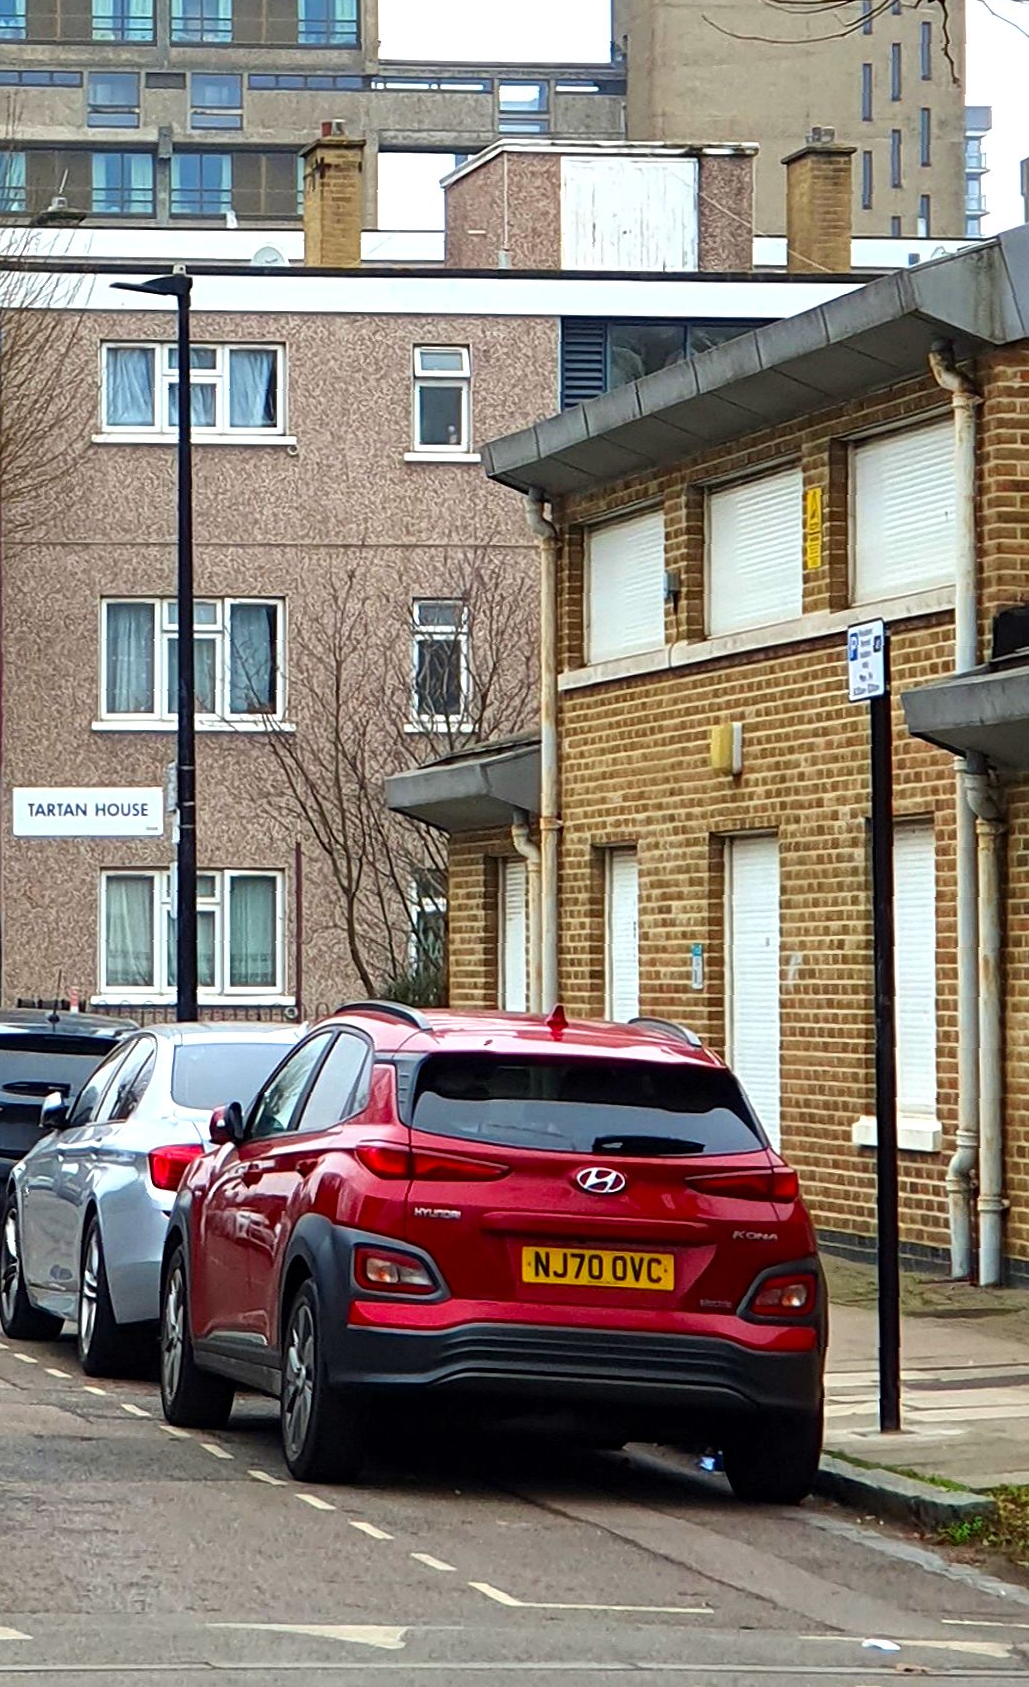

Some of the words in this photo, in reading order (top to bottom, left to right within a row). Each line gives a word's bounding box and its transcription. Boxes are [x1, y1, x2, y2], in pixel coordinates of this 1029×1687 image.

[28, 802, 87, 817] TARTAN
[95, 802, 149, 817] HOUSE
[414, 1207, 461, 1219] HYUNDAI
[732, 1230, 778, 1241] KONA
[534, 1250, 604, 1280] NJ70
[611, 1255, 663, 1284] OVC
